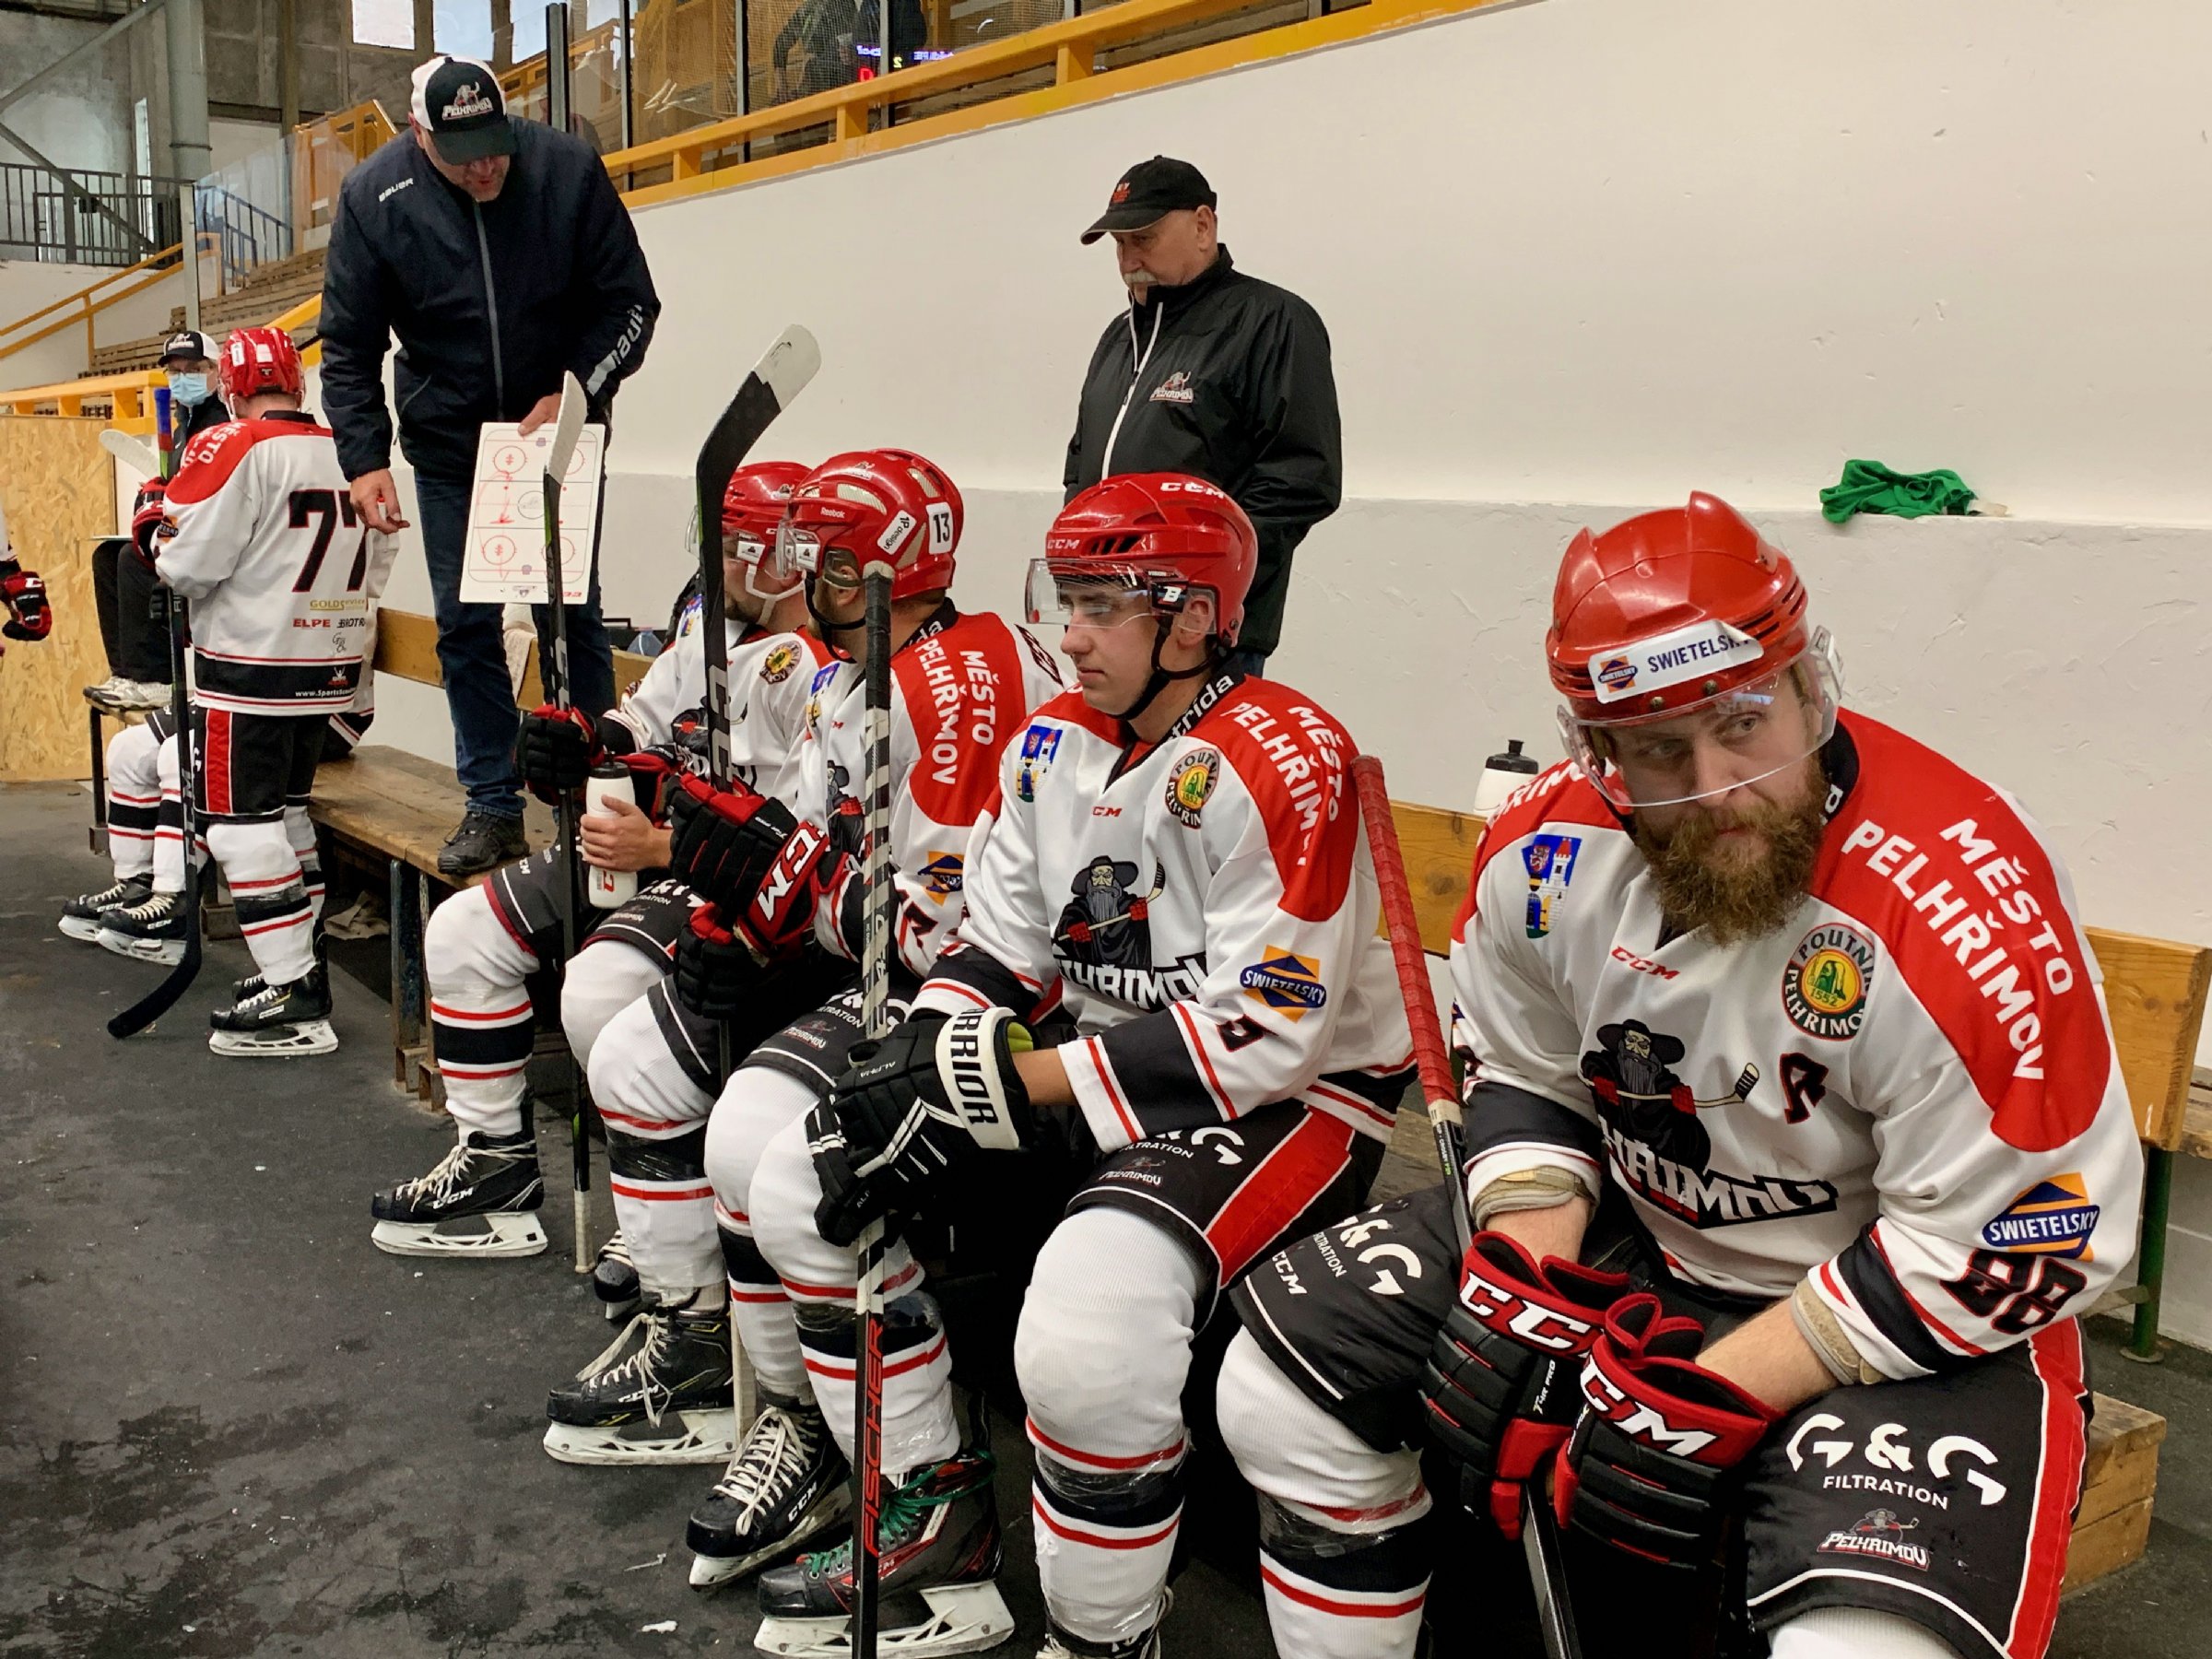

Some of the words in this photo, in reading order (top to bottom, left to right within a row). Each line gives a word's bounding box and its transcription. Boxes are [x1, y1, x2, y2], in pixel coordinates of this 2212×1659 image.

[820, 506, 846, 519] Reebok
[1160, 481, 1226, 500] CCM
[288, 488, 366, 593] 77
[883, 526, 904, 550] design
[933, 512, 951, 544] 13
[1047, 538, 1080, 550] CCM
[292, 618, 331, 629] ELPE
[1648, 633, 1749, 674] SWIETELSK
[914, 638, 968, 784] PELHŘIMOV
[959, 650, 1000, 746] MĚSTO
[1219, 701, 1324, 866] PELHŘIM
[1288, 706, 1344, 822] MĚSTO
[757, 826, 829, 922] CM
[1939, 818, 2074, 995] MĚSTO
[1610, 946, 1681, 981] CCM
[1841, 819, 2044, 1080] PELHŘIMOV
[1243, 969, 1326, 1007] SWIETELSKY
[1784, 969, 1864, 1036] PELHŘIMO
[1811, 987, 1839, 1007] 1552
[950, 1008, 999, 1126] RRIOR
[1989, 1209, 2099, 1242] SWIETELSKY
[1272, 1251, 1309, 1295] CCM
[1460, 1272, 1593, 1353] CC
[1580, 1353, 1717, 1456] CM
[865, 1318, 884, 1558] FISCHER
[788, 1483, 818, 1523] CCM
[1823, 1474, 1948, 1511] FILTRATION
